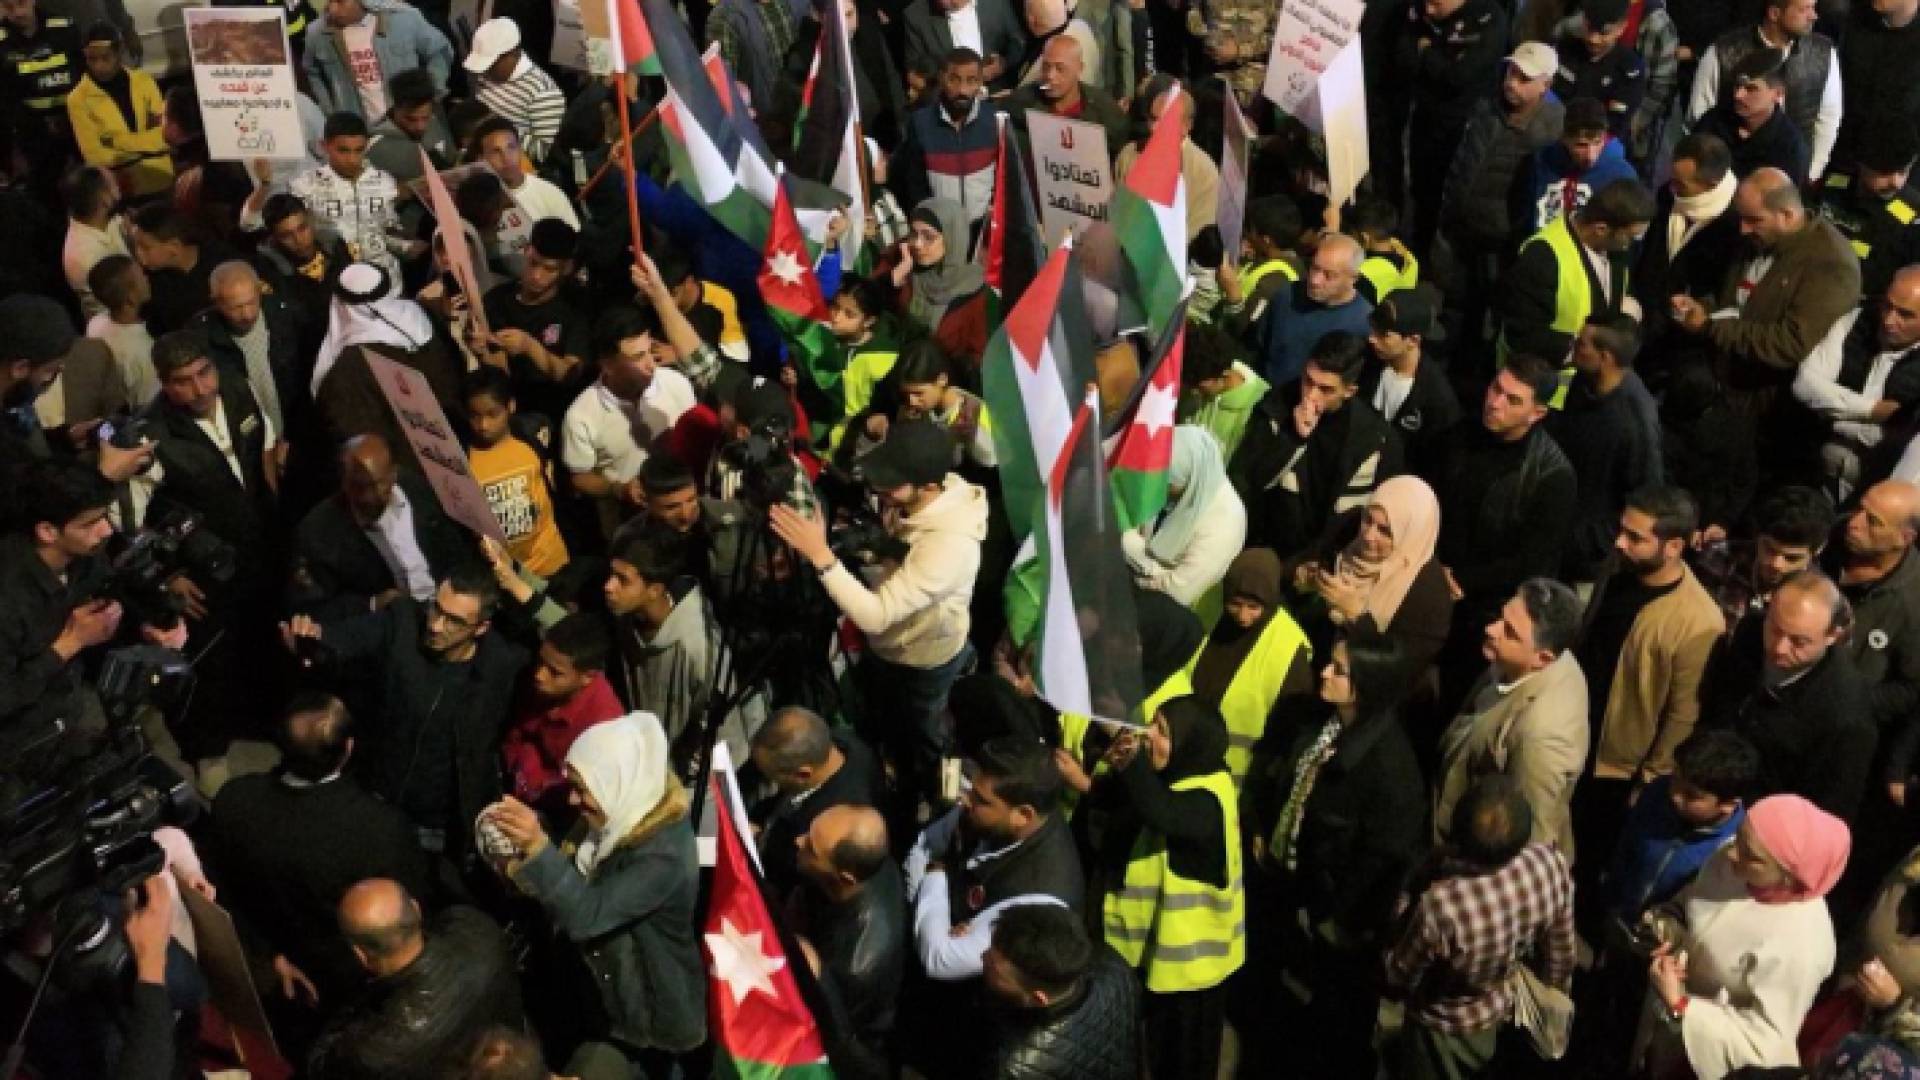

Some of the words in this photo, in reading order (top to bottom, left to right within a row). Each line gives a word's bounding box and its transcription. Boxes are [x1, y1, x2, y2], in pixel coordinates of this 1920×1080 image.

[1060, 126, 1073, 149] لا
[1043, 155, 1100, 188] تعتادوا
[1047, 191, 1109, 223] المشهد
[395, 369, 411, 395] لا
